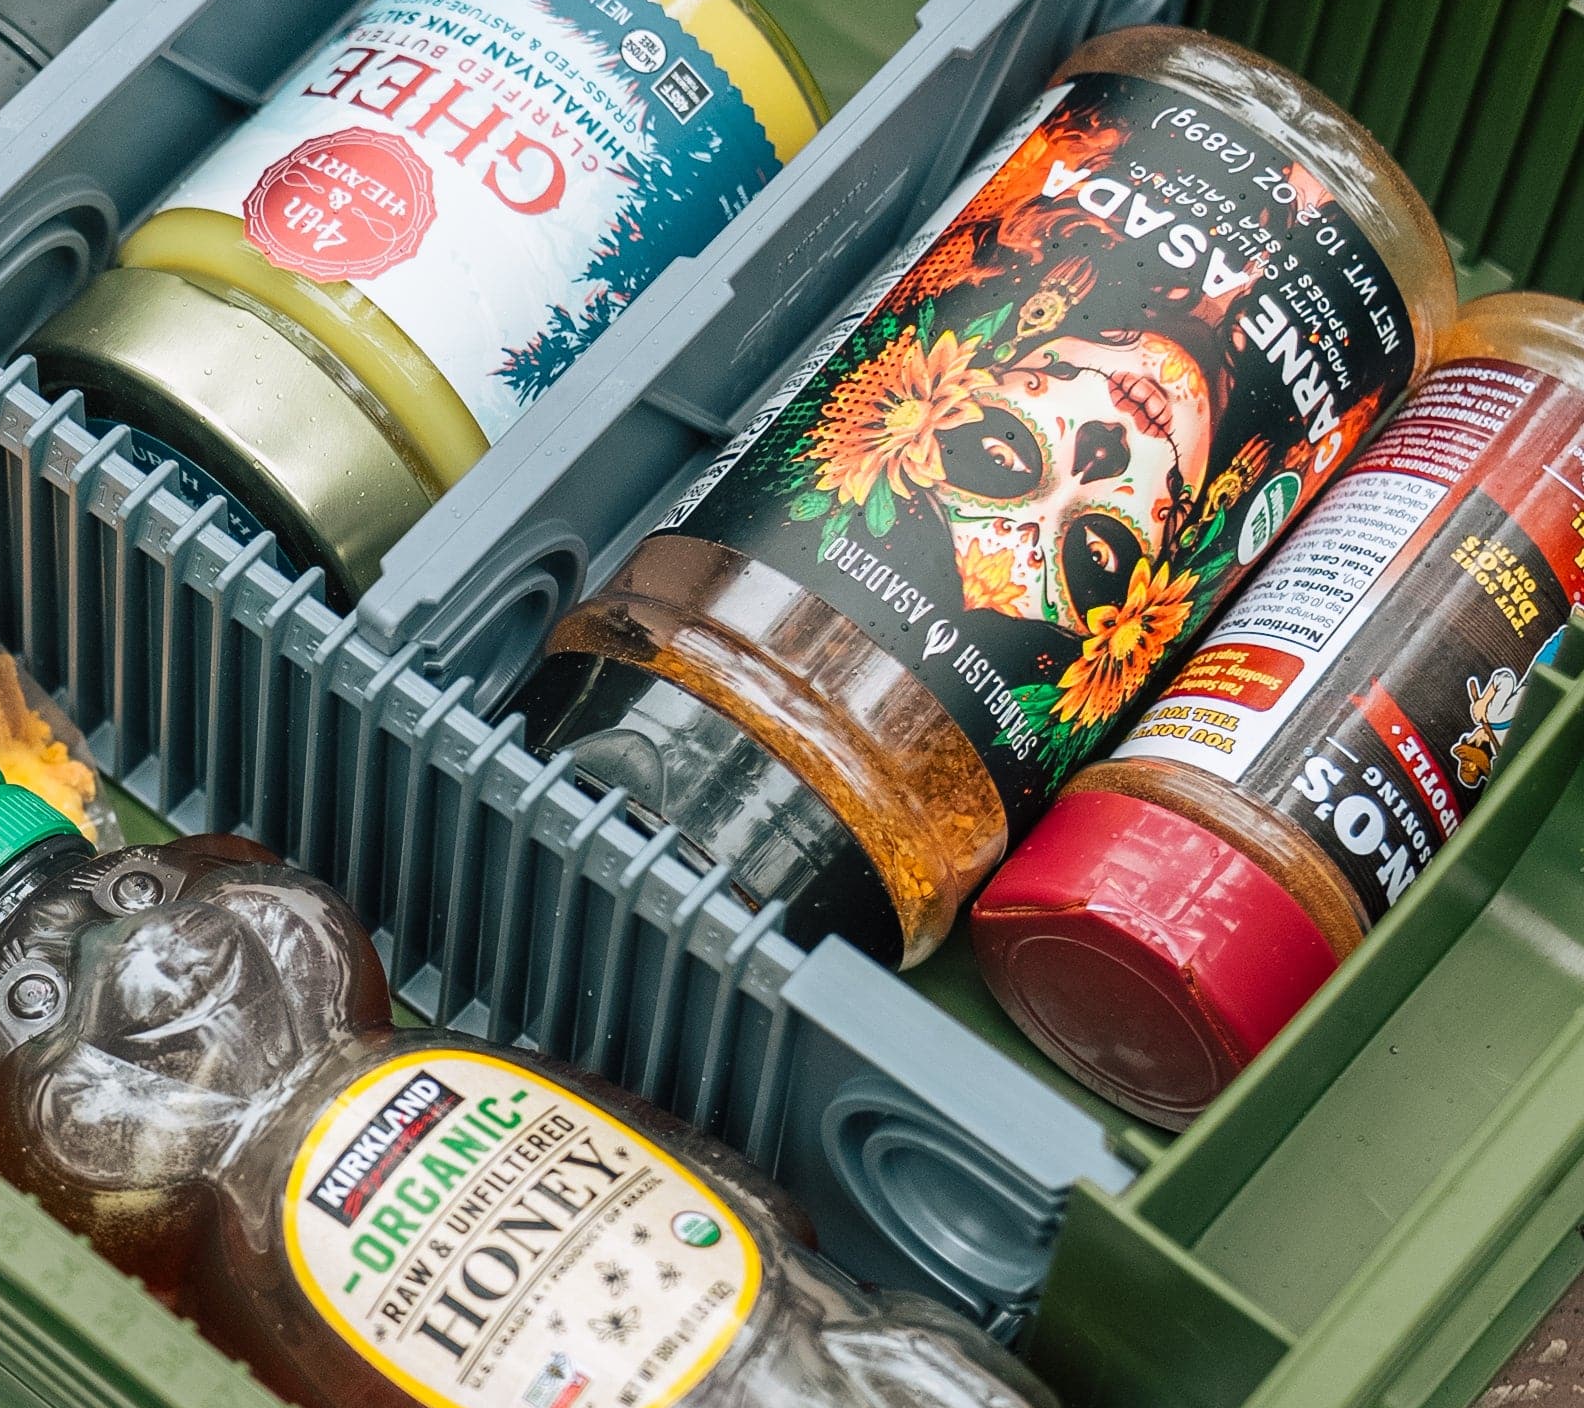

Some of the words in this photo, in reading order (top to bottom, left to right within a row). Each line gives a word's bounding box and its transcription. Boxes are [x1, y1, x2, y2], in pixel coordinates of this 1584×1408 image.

[422, 14, 479, 48] PINK
[526, 35, 543, 53] &
[621, 39, 657, 70] LACTOSE
[638, 34, 660, 55] FREE
[455, 55, 600, 172] CLARIFIED
[482, 39, 623, 161] HIMALAYAN
[542, 46, 637, 134] GRASS-FED
[303, 38, 563, 218] GHEE
[1151, 104, 1252, 175] (289g)
[325, 185, 352, 213] &
[1127, 159, 1208, 216] GARLIC,
[1178, 168, 1236, 213] SALT
[1252, 164, 1299, 206] OZ
[279, 194, 347, 260] 4th
[1039, 157, 1249, 292] ASADA
[1216, 214, 1281, 281] CHILIS,
[1240, 213, 1282, 253] SEA
[1295, 201, 1347, 255] 10.2
[1282, 253, 1299, 270] &
[1343, 253, 1381, 303] WT.
[1280, 281, 1321, 332] WITH
[1296, 272, 1350, 341] SPICES
[1371, 303, 1404, 352] NET
[1236, 293, 1343, 469] CARNE
[1317, 334, 1352, 389] MADE
[1431, 407, 1503, 432] DISTRIBUTED
[1430, 453, 1468, 471] chipotle
[1310, 554, 1339, 565] Carb.
[1338, 542, 1386, 563] Protein
[1357, 531, 1397, 548] source
[821, 533, 934, 627] ASADERO
[1292, 566, 1338, 580] Sodium
[1293, 580, 1353, 602] Calories
[1342, 558, 1374, 576] Total
[1450, 547, 1498, 595] SOME
[1459, 532, 1539, 624] DAN-O'S
[1512, 563, 1539, 593] ON
[1254, 619, 1323, 642] Nutrition
[1285, 606, 1334, 627] Servings
[1325, 600, 1344, 614] tsp
[1214, 648, 1248, 663] Soups
[1224, 663, 1282, 691] Smoking
[951, 643, 1038, 758] SPANGLISH
[1216, 679, 1243, 696] Pan
[1188, 727, 1235, 754] YOU
[1191, 706, 1239, 731] TILL
[1395, 735, 1459, 837] IPOTLE
[1291, 748, 1416, 907] N-O'S
[1360, 762, 1433, 862] SONING
[315, 1072, 443, 1210] KIRKLAND
[380, 1258, 436, 1325] RAW
[428, 1234, 454, 1259] &
[444, 1112, 575, 1236] UNFILTERED
[414, 1132, 625, 1364] HONEY
[490, 1304, 533, 1358] GRADE
[548, 1221, 608, 1282] PRODUCT
[602, 1205, 623, 1225] OF
[620, 1172, 664, 1210] BRAZIL
